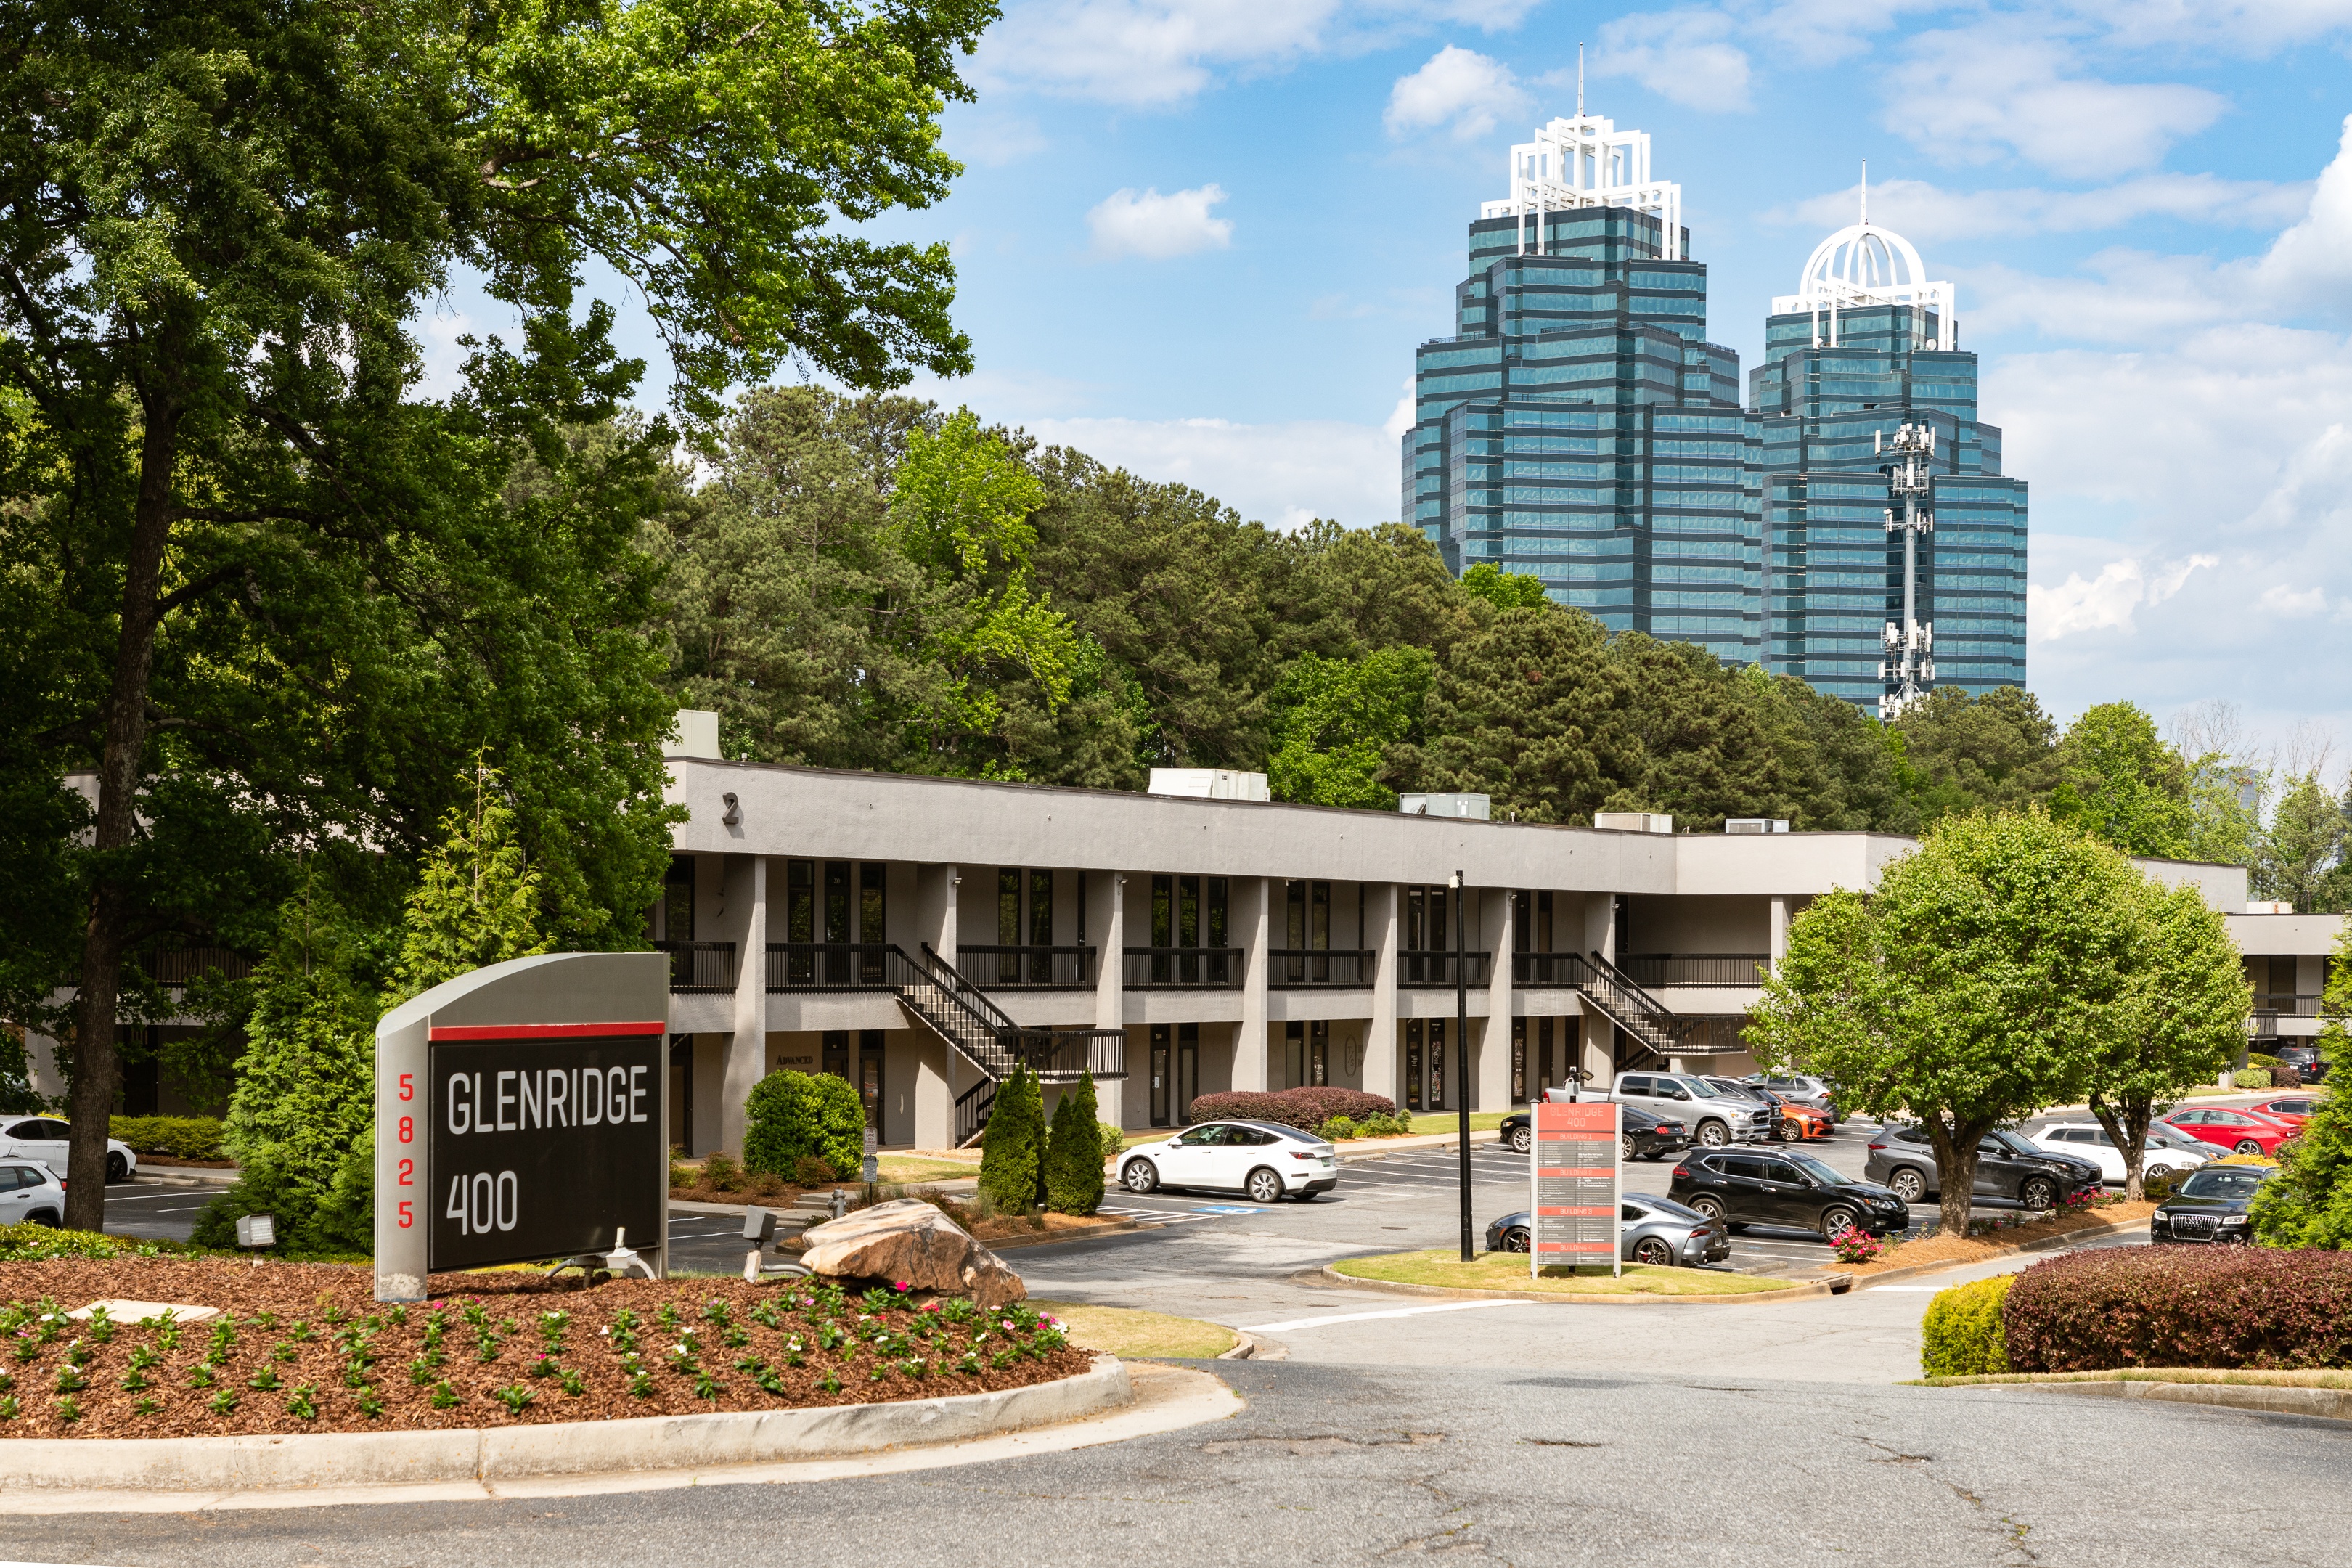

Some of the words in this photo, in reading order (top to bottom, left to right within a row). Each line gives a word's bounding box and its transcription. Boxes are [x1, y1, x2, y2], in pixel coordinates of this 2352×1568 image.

[722, 791, 739, 825] 2
[776, 1055, 814, 1065] ADVANCED
[448, 1065, 648, 1135] GLENRIDGE
[1550, 1107, 1604, 1116] GLENRIDGE
[1567, 1117, 1585, 1127] 400
[446, 1170, 518, 1236] 400
